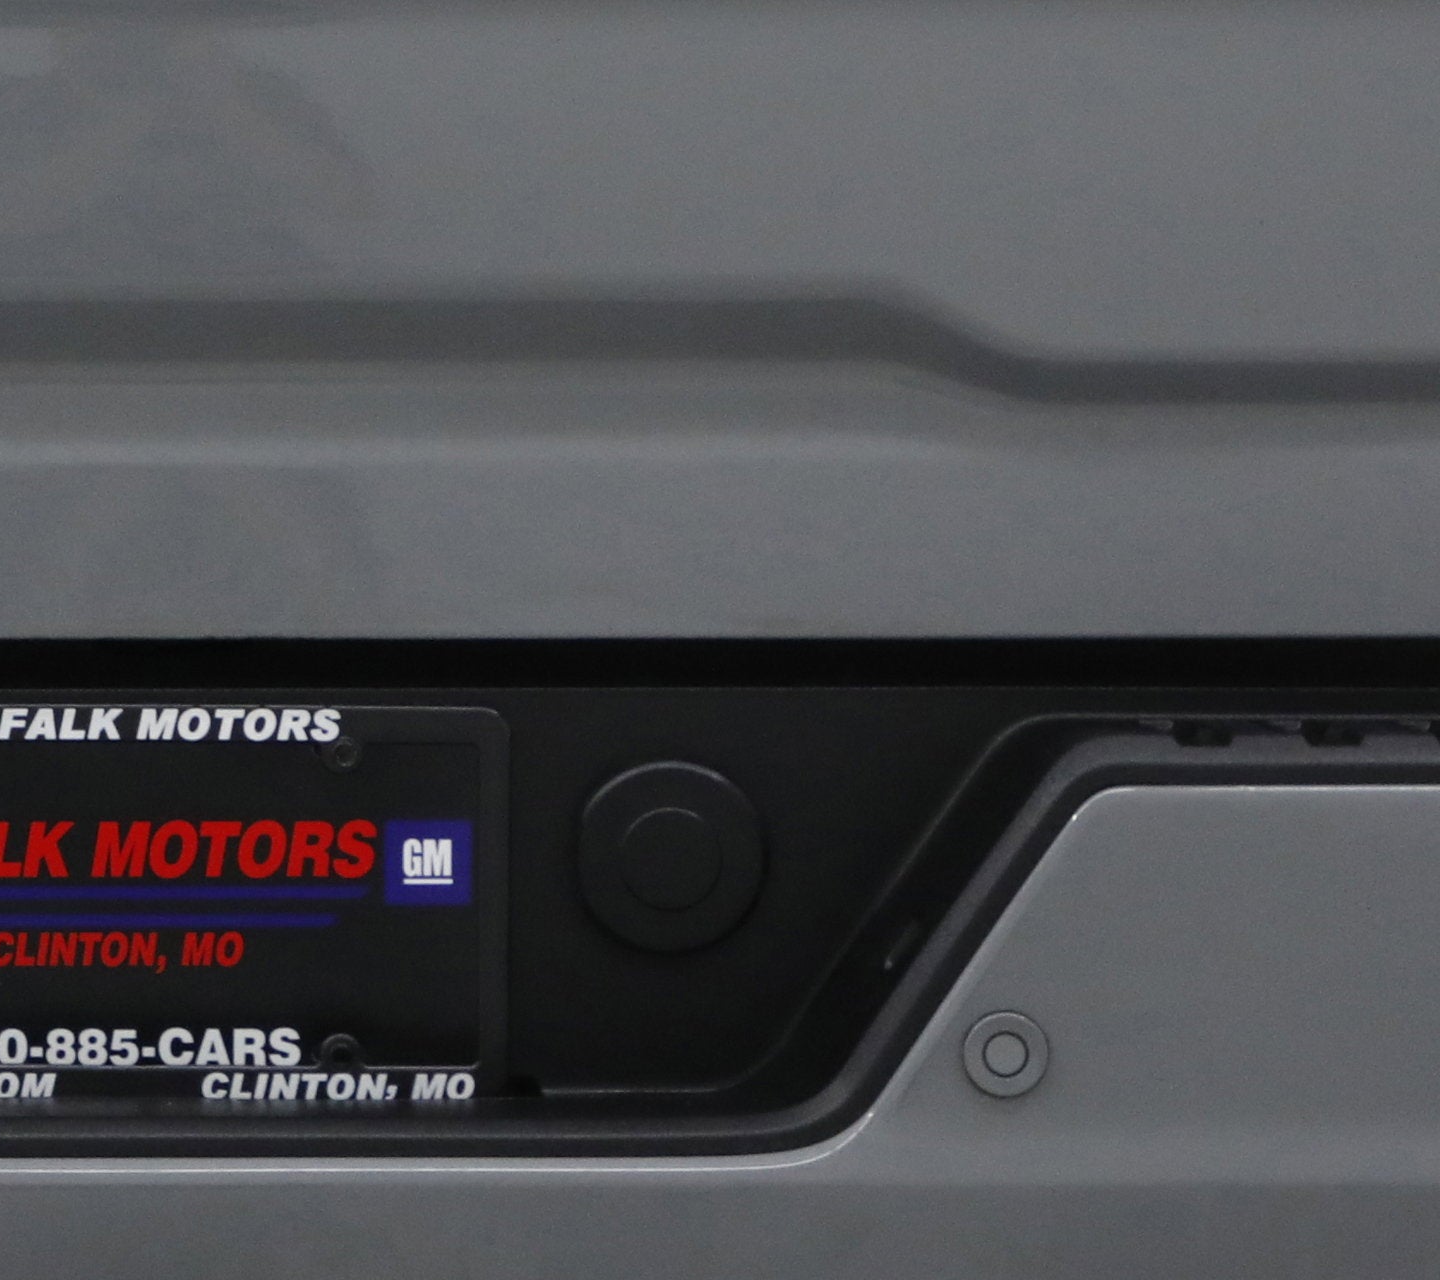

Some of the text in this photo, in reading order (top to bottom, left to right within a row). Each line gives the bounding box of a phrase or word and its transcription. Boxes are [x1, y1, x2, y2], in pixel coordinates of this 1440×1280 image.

[135, 705, 343, 743] MOTORS
[90, 819, 379, 881] MOTORS
[402, 838, 453, 878] GM
[181, 931, 245, 968] MO
[201, 1072, 476, 1100] CLINTON, MO
